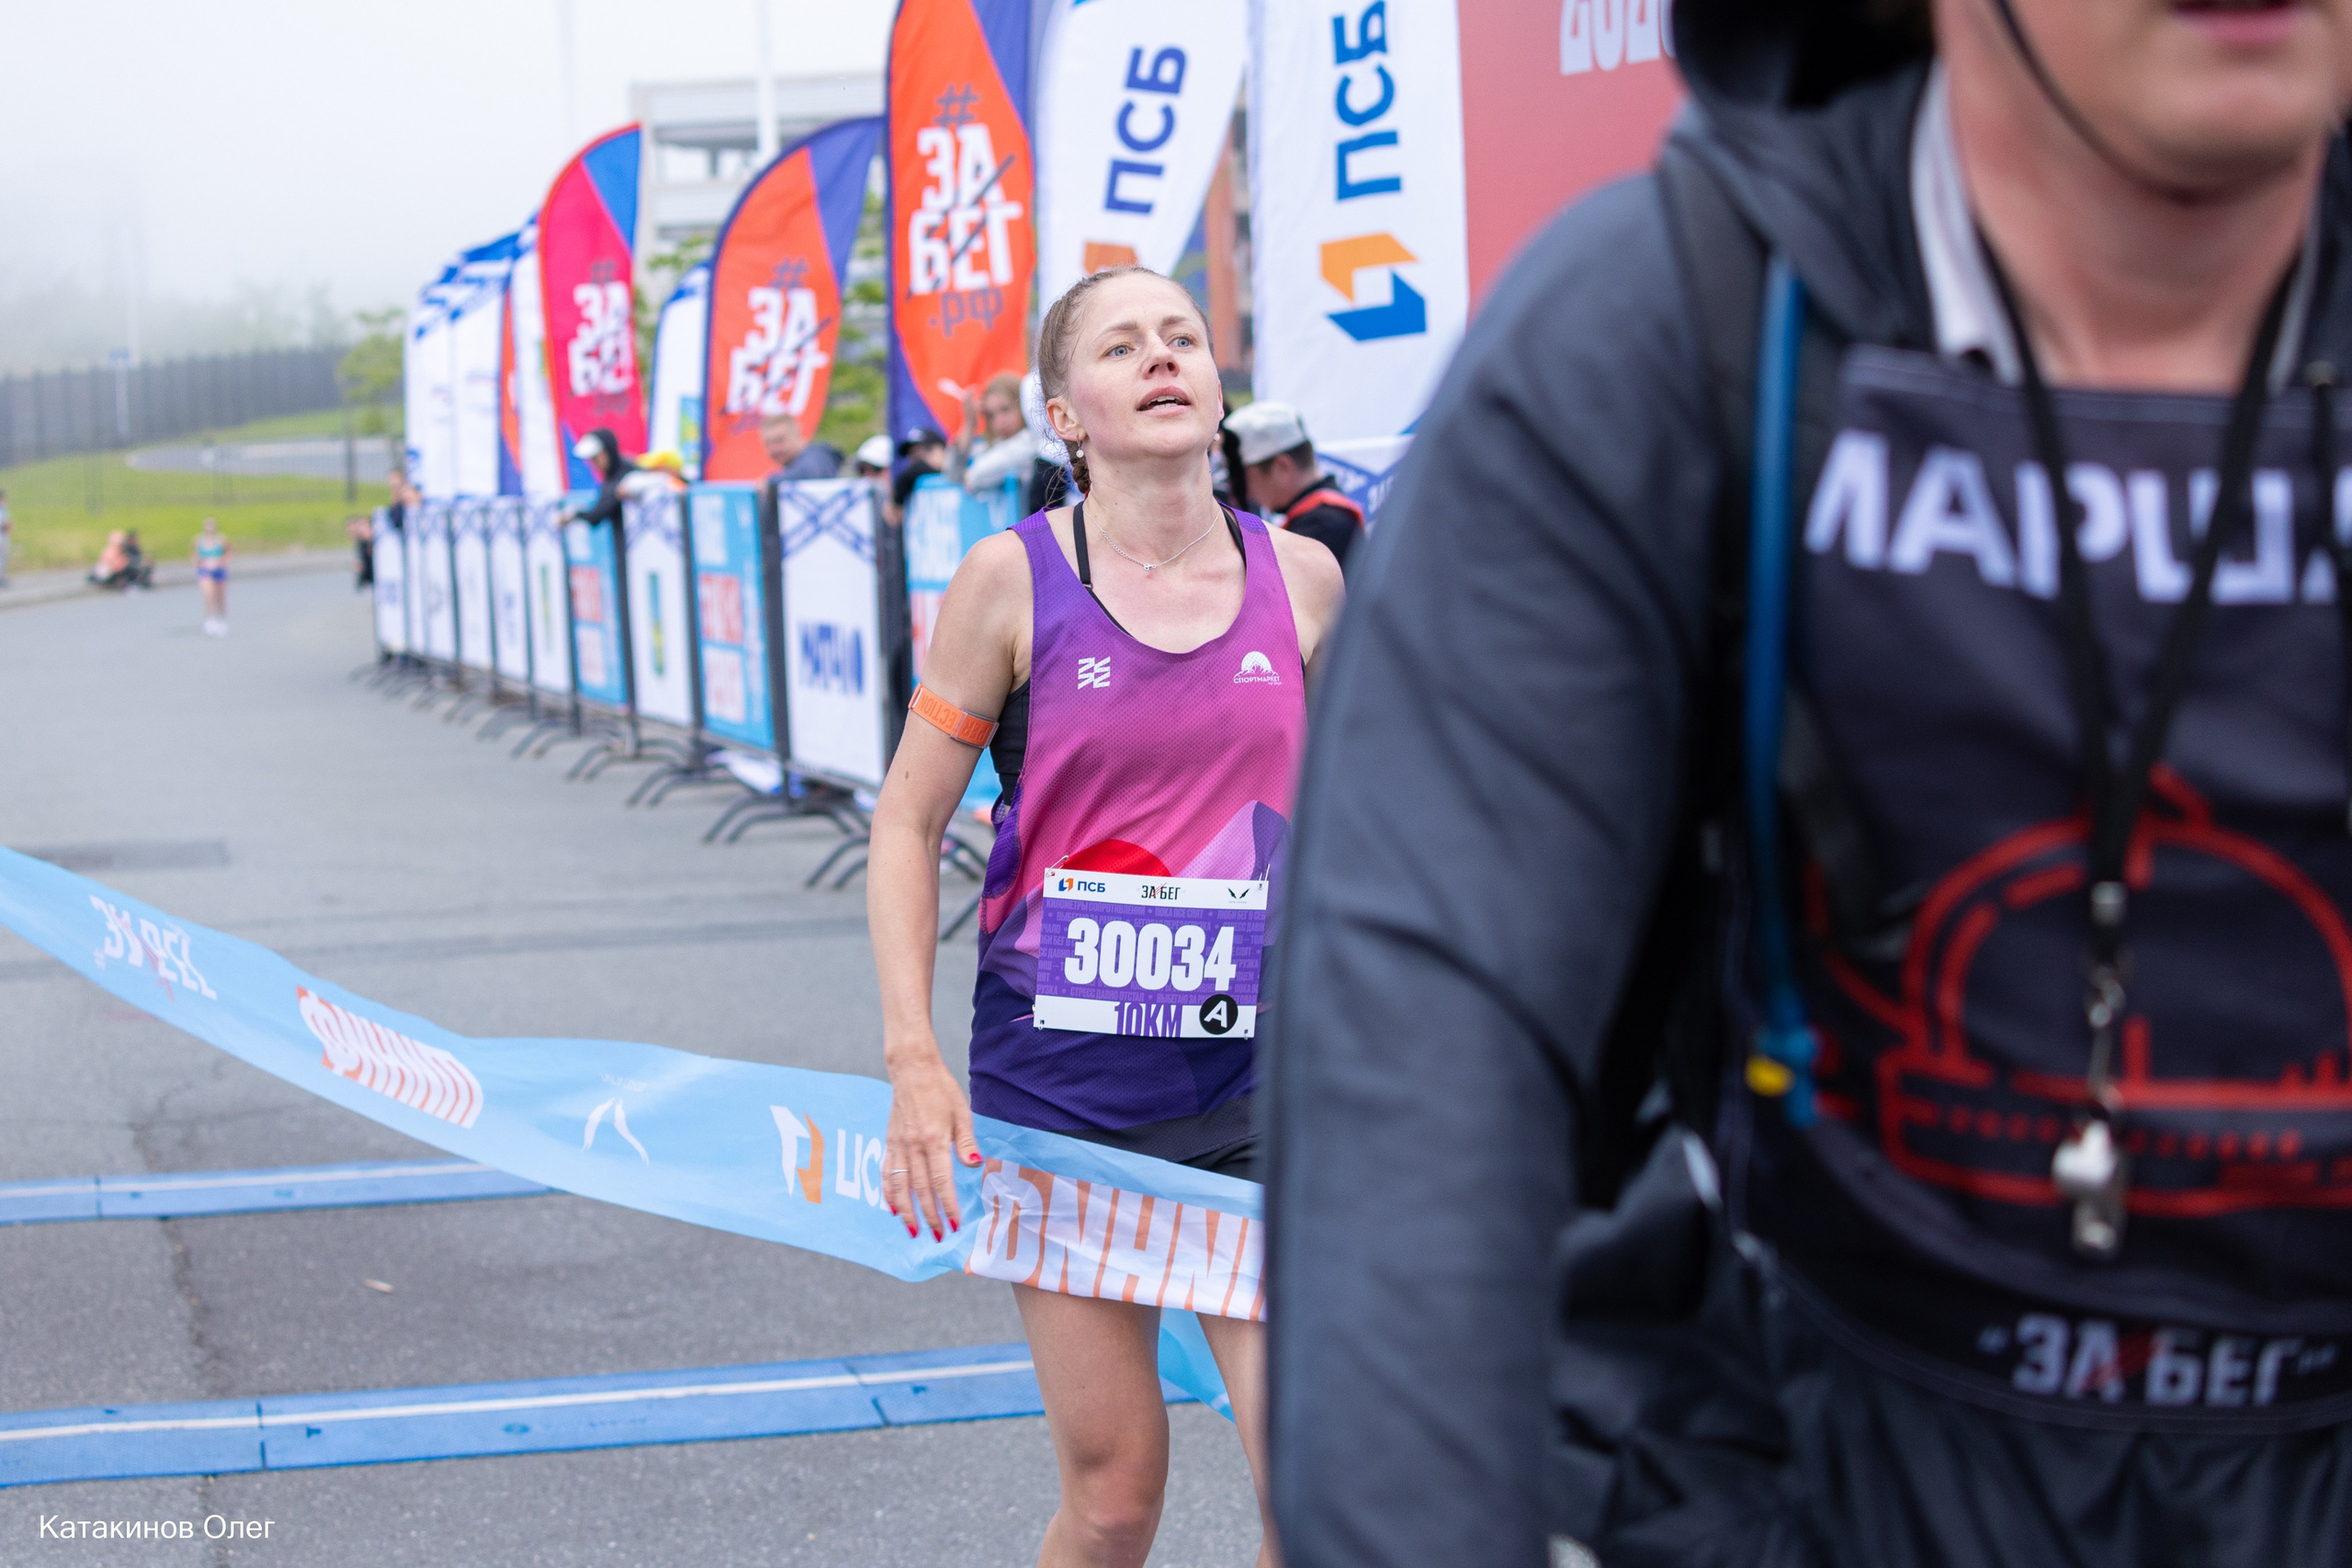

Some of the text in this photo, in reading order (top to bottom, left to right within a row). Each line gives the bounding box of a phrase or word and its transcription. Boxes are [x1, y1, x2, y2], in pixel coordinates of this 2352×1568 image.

[1103, 47, 1187, 214] ПСБ
[1331, 0, 1401, 201] ПСБ
[916, 123, 1006, 209] ЗА
[909, 201, 1023, 294] БЕГ
[745, 286, 820, 361] ЗА
[918, 692, 990, 742] PERECTION
[1233, 675, 1281, 684] СПОРТМАРКЕТ
[1077, 880, 1106, 893] ПСБ
[1141, 885, 1182, 900] ЗА БЕГ
[1065, 917, 1237, 992] 30034
